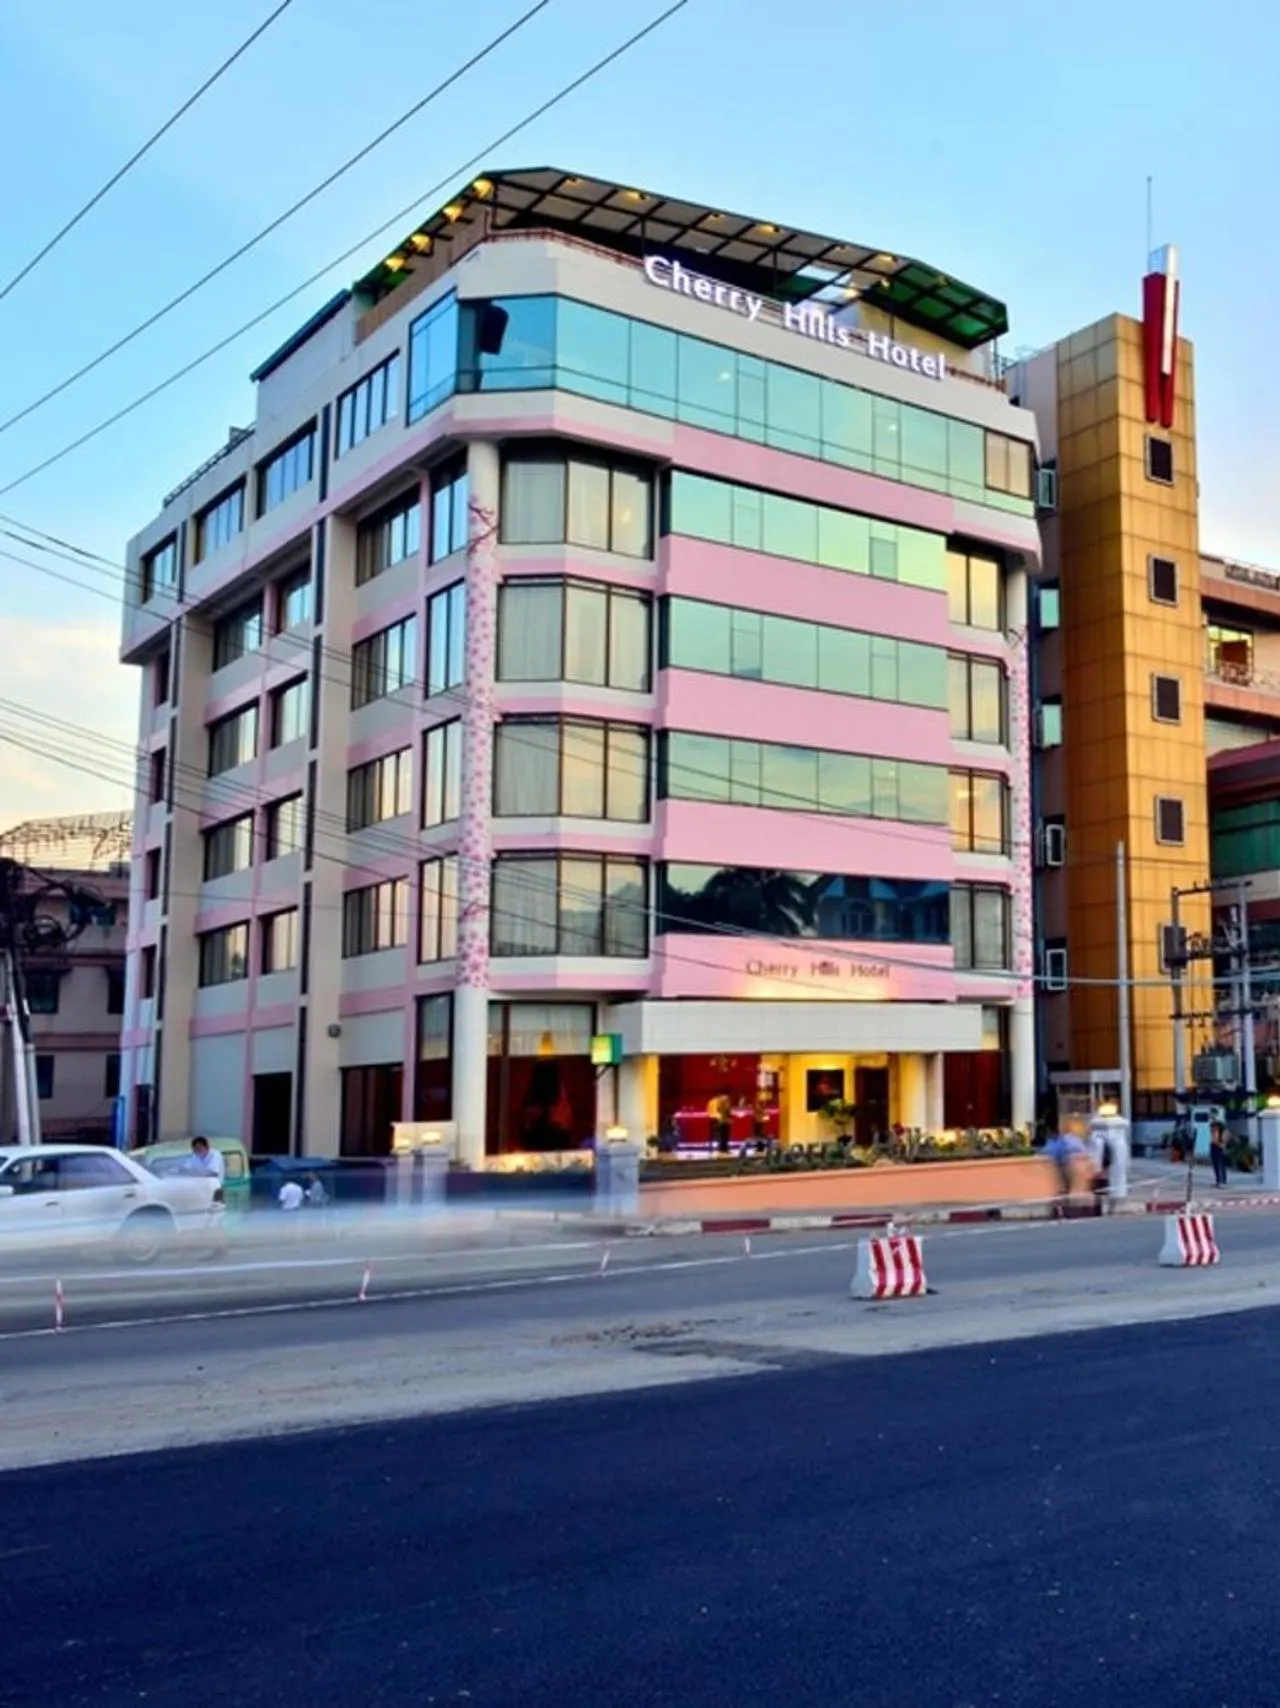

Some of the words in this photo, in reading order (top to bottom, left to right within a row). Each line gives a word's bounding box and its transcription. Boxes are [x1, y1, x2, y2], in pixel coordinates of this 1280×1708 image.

[644, 254, 763, 322] Cherry
[784, 301, 851, 347] Hills
[867, 331, 946, 380] Hotel
